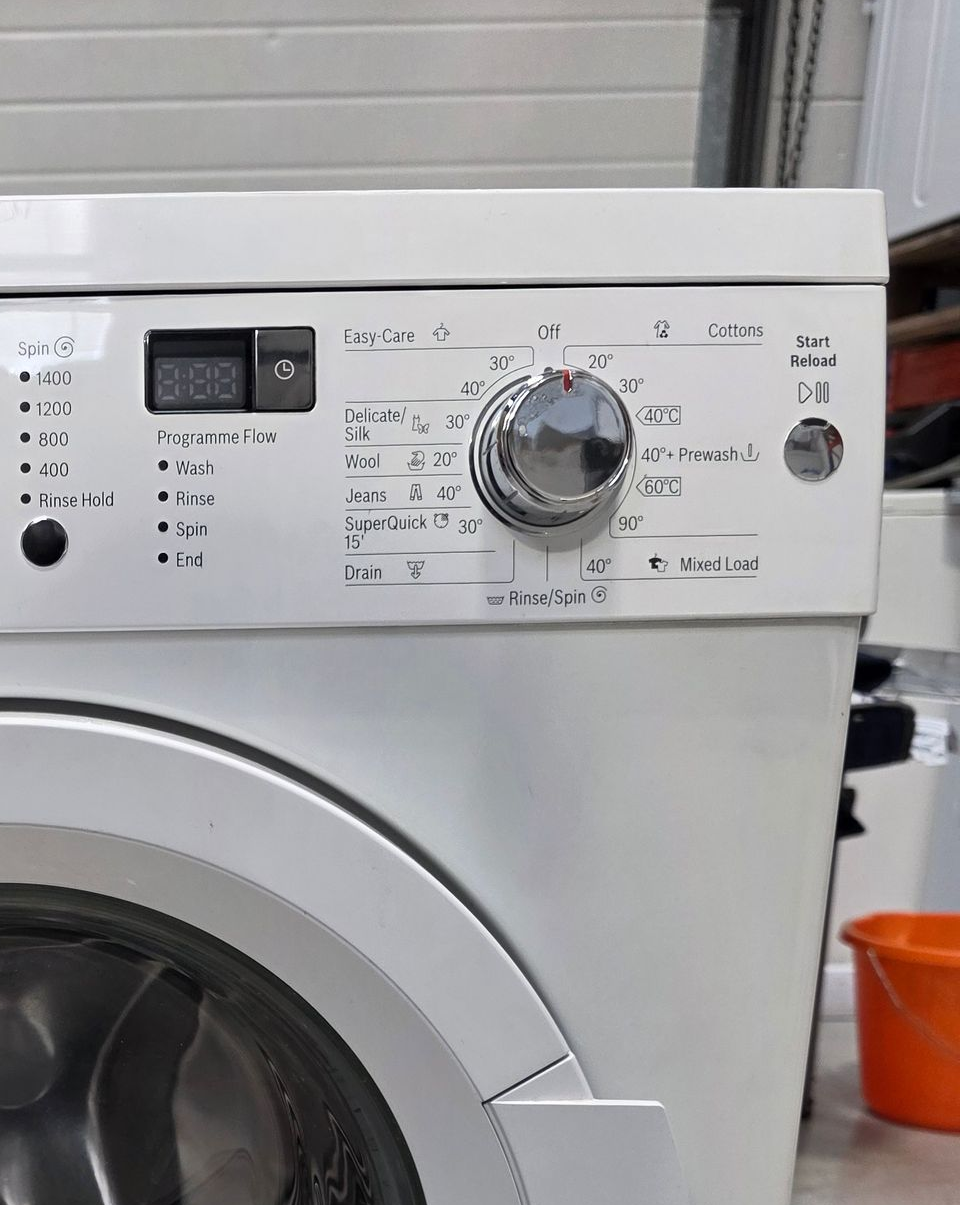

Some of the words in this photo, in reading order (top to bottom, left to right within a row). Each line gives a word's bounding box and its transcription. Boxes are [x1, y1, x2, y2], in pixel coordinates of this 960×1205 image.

[344, 328, 415, 346] Easy-Care
[538, 324, 560, 339] Off
[709, 323, 763, 337] Cottons
[18, 341, 49, 358] Spin
[797, 336, 830, 348] Start
[791, 354, 836, 367] Reload
[37, 371, 71, 385] 1400
[37, 402, 71, 416] 1200
[345, 407, 406, 425] Delicate/
[39, 432, 68, 446] 800
[158, 430, 239, 448] Programme
[244, 429, 276, 443] Flow
[345, 426, 369, 441] Silk
[345, 453, 379, 468] Wool
[680, 447, 737, 461] Prewash
[40, 462, 68, 477] 400
[176, 460, 213, 475] Wash
[40, 493, 77, 507] Rinse
[83, 491, 113, 506] Hold
[177, 491, 214, 505] Rinse
[346, 489, 386, 503] Jeans
[177, 522, 207, 540] Spin
[345, 514, 427, 533] SuperQuick
[177, 552, 202, 567] End
[681, 556, 720, 571] Mixed
[726, 556, 758, 571] Load
[345, 565, 381, 580] Drain
[510, 589, 585, 607] Rinse/Spin
